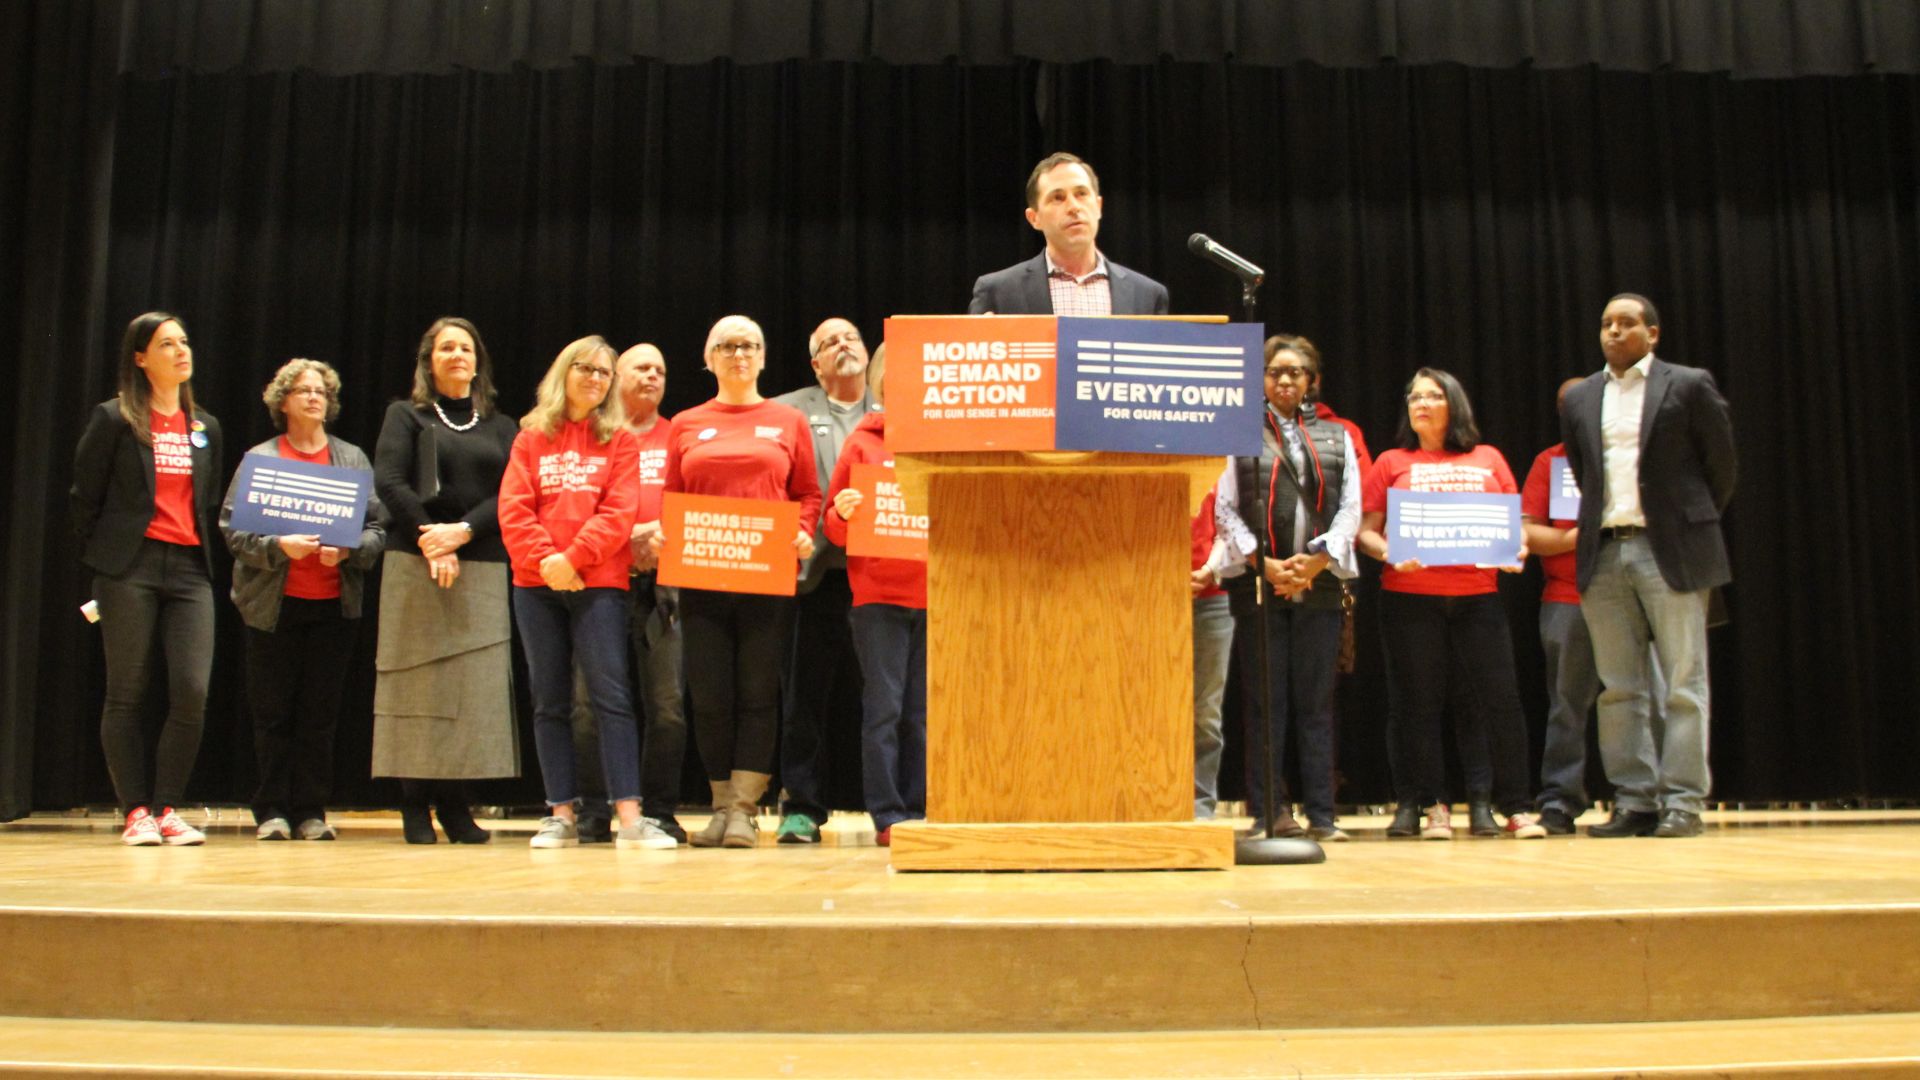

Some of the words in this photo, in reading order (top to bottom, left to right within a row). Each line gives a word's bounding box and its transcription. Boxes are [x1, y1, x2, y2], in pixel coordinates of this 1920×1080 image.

[923, 342, 1007, 361] MOMS
[923, 363, 1041, 383] DEMAND
[923, 384, 1025, 405] ACTION
[1076, 381, 1244, 407] EVERYTOWN
[923, 409, 942, 419] FOR
[944, 409, 964, 418] GUN
[967, 408, 997, 418] SENSE
[1000, 408, 1008, 417] IN
[1010, 408, 1055, 418] AMERICA
[1104, 408, 1130, 419] FOR
[1133, 409, 1162, 421] GUN
[1164, 411, 1215, 422] SAFETY
[152, 432, 181, 444] OMS
[248, 491, 354, 518] EVERYTOWN
[262, 508, 280, 517] FOR
[281, 511, 300, 520] GUN
[301, 514, 334, 525] SAFETY
[684, 511, 740, 529] MOMS
[875, 511, 929, 529] ACTIO
[684, 526, 763, 546] DEMAND
[1399, 525, 1510, 541] EVERYTOWN
[682, 541, 751, 560] ACTION
